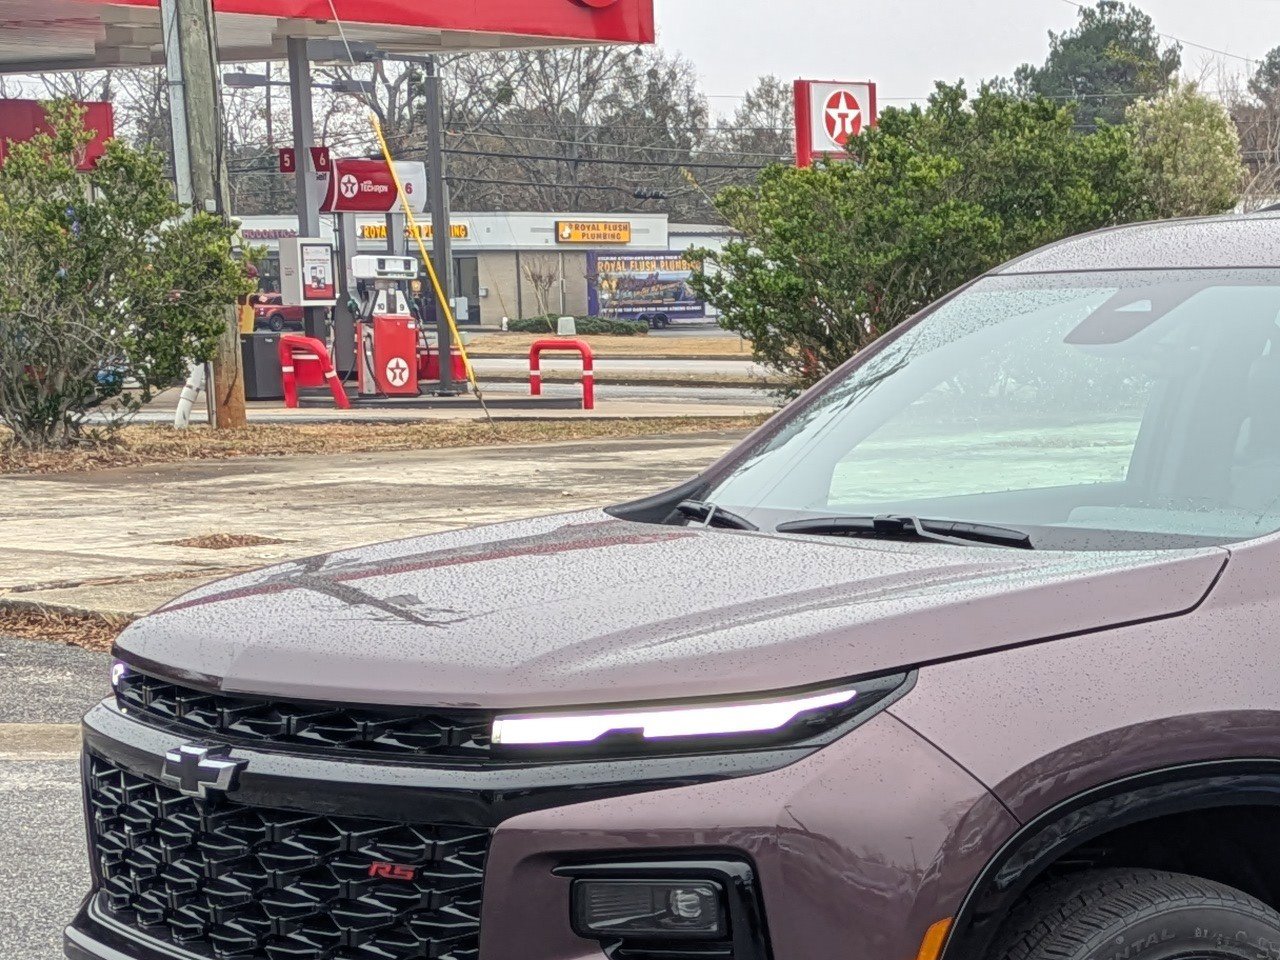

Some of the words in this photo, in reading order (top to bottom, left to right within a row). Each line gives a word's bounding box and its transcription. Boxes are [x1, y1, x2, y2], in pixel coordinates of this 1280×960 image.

[283, 154, 291, 167] 5
[319, 152, 326, 166] 6
[404, 182, 413, 195] 6
[363, 225, 388, 239] ROYA
[574, 223, 601, 231] ROYAL
[603, 223, 629, 231] FLUSH
[581, 232, 622, 240] PLUMBING
[597, 260, 627, 273] ROYAL
[630, 260, 657, 272] FLUSH
[659, 259, 702, 271] PLUMB
[377, 303, 385, 311] 10
[367, 861, 416, 880] RS
